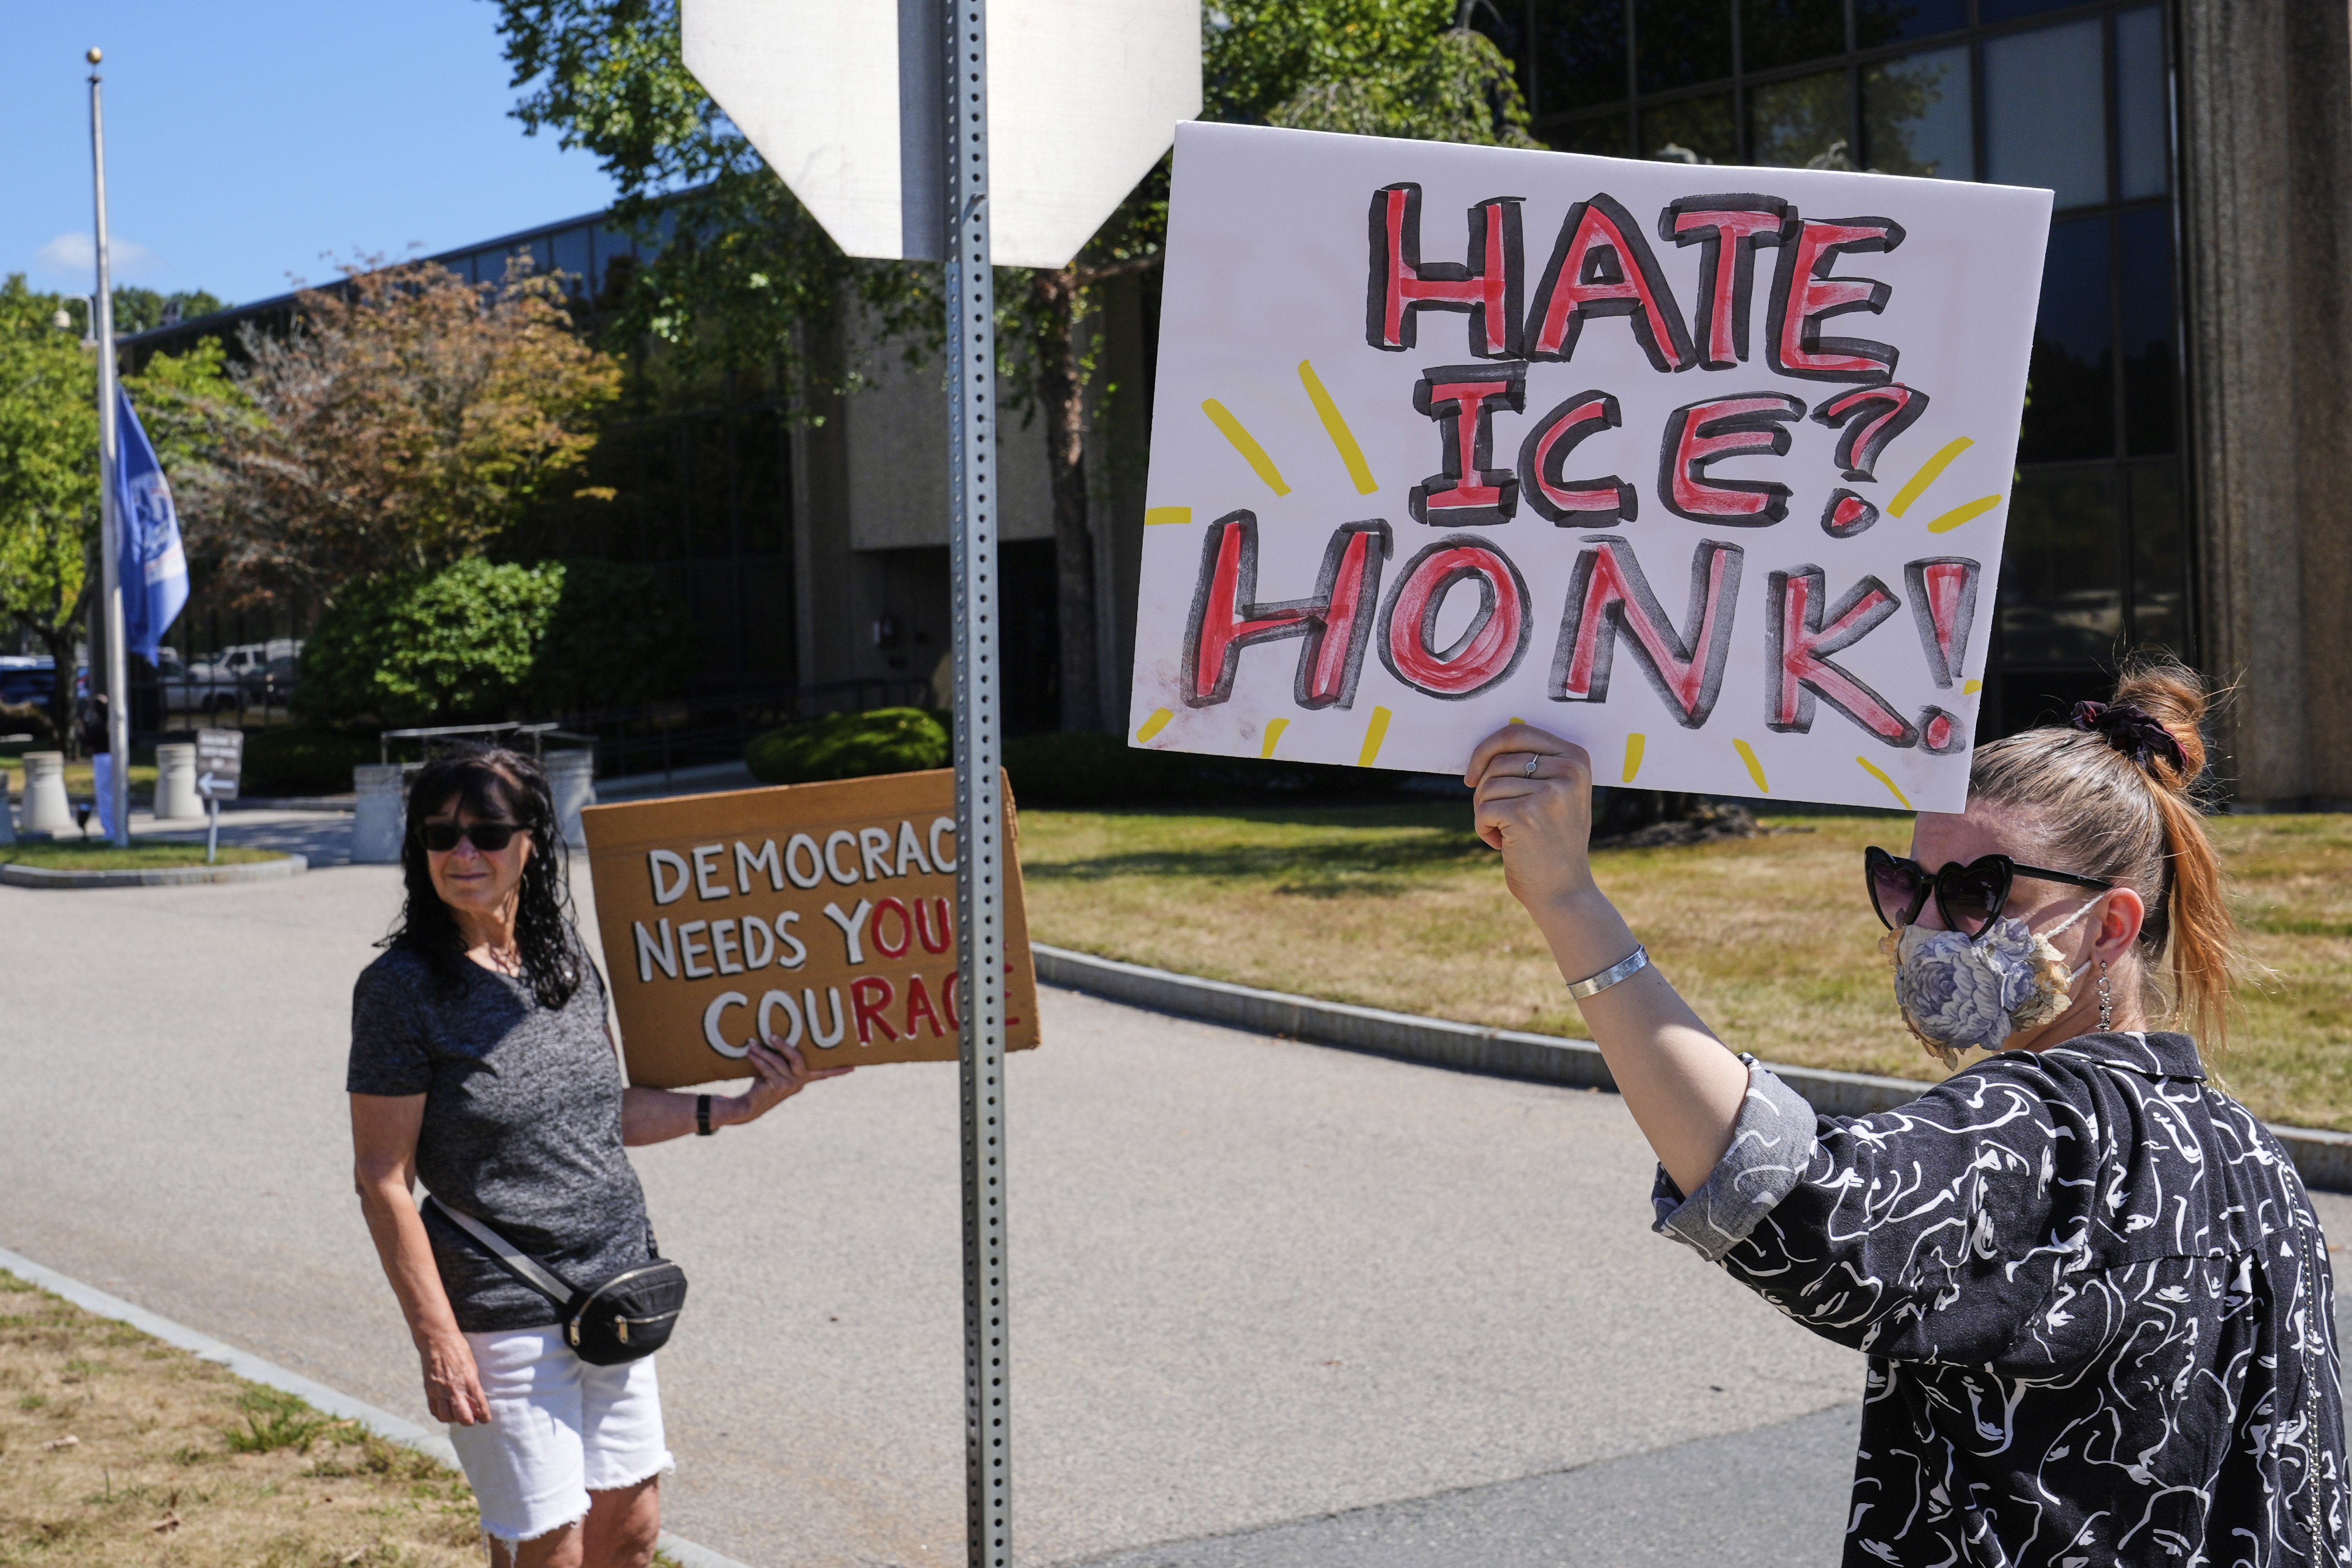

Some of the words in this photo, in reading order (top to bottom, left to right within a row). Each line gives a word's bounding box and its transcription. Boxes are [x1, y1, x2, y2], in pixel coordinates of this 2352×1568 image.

[1367, 182, 1906, 384] HATE
[1409, 360, 1930, 539] ICE?
[1180, 509, 1980, 755] HONK!
[635, 910, 807, 982] NEEDS
[649, 816, 957, 904] DEMOCRAC
